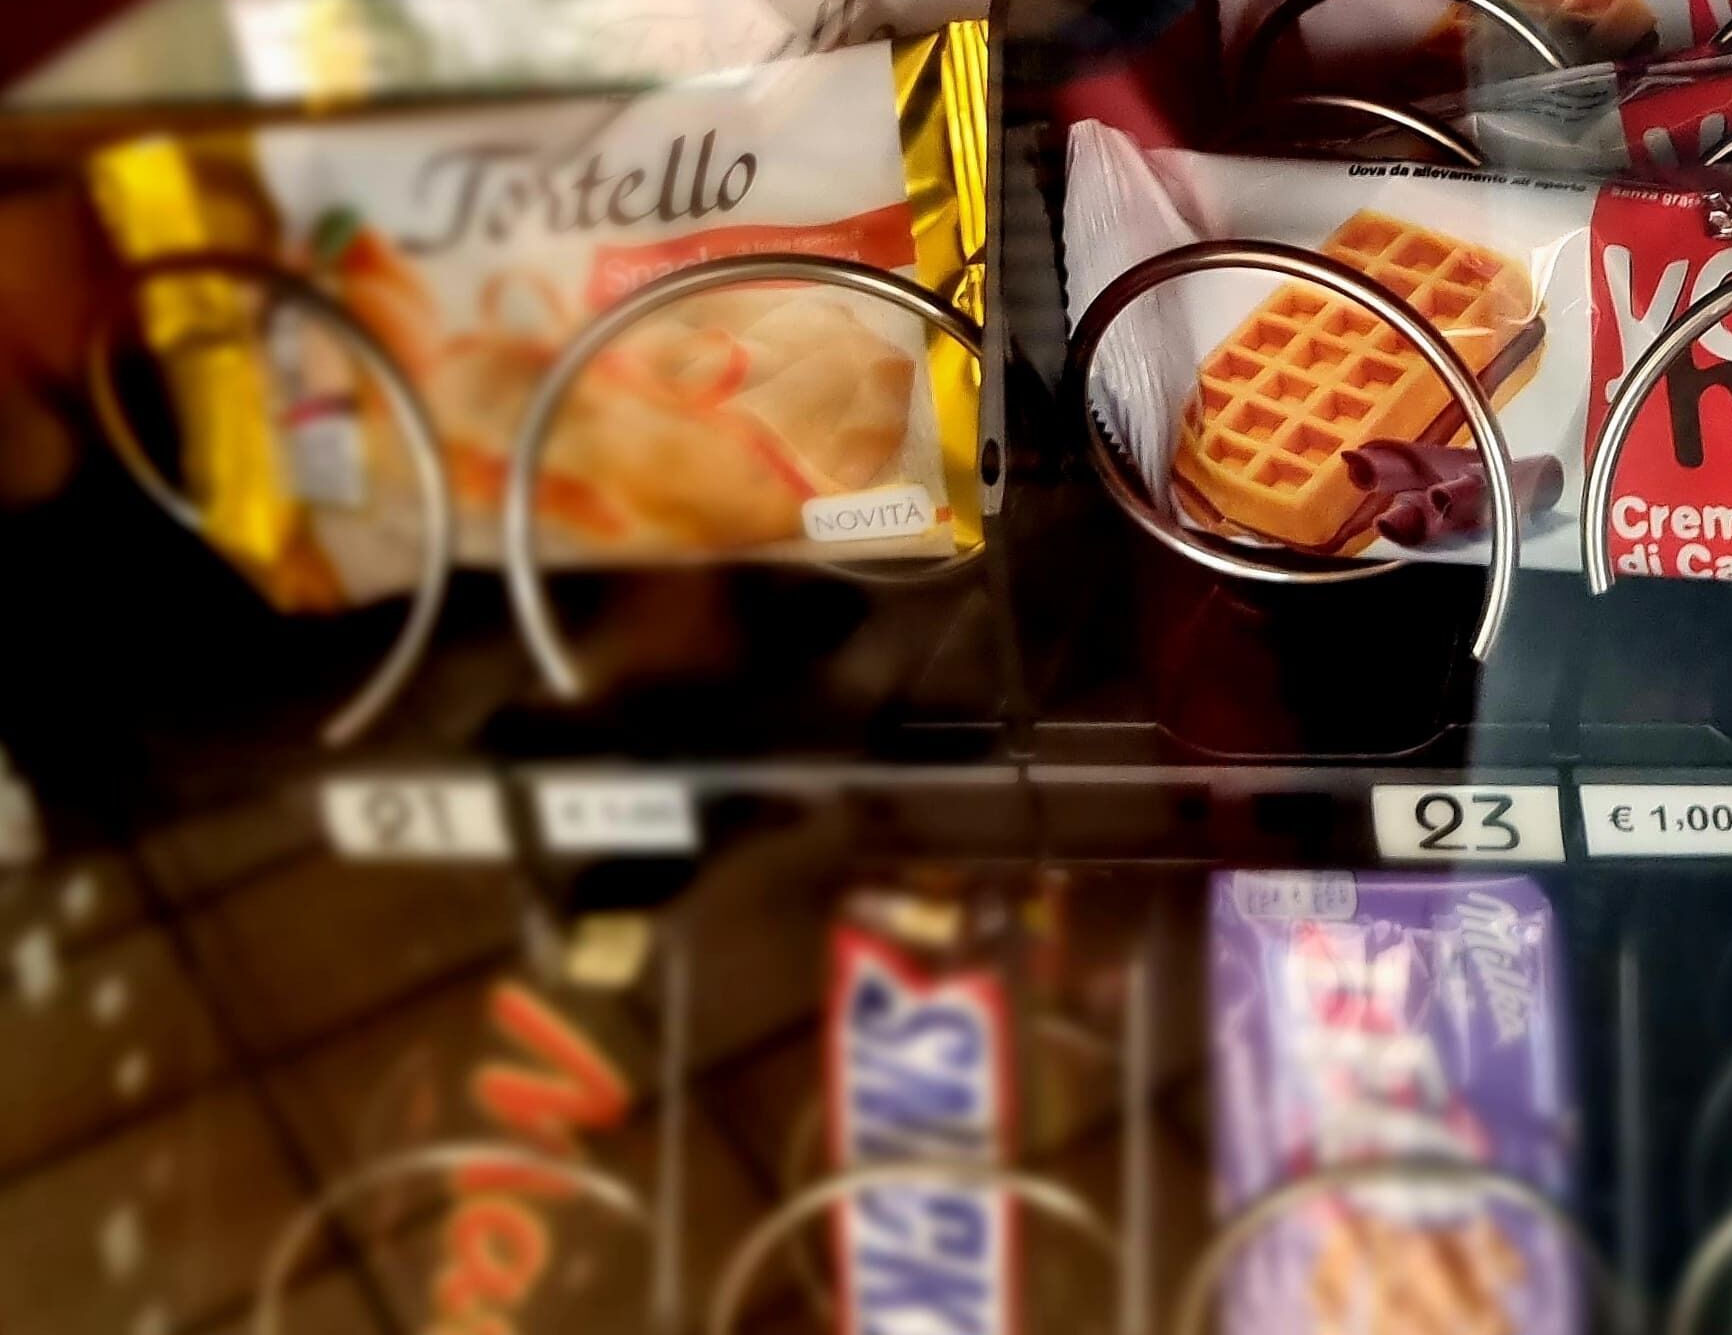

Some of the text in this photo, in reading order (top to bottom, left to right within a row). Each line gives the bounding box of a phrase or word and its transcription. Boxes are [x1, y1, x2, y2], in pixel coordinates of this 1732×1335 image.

[1349, 164, 1386, 177] Uova
[1390, 164, 1410, 177] da
[400, 128, 758, 254] Tortello
[814, 496, 925, 533] NOVITÀ
[1616, 544, 1662, 577] di
[1415, 792, 1522, 852] 23
[1608, 805, 1635, 834] €
[850, 974, 988, 1335] SNICK
